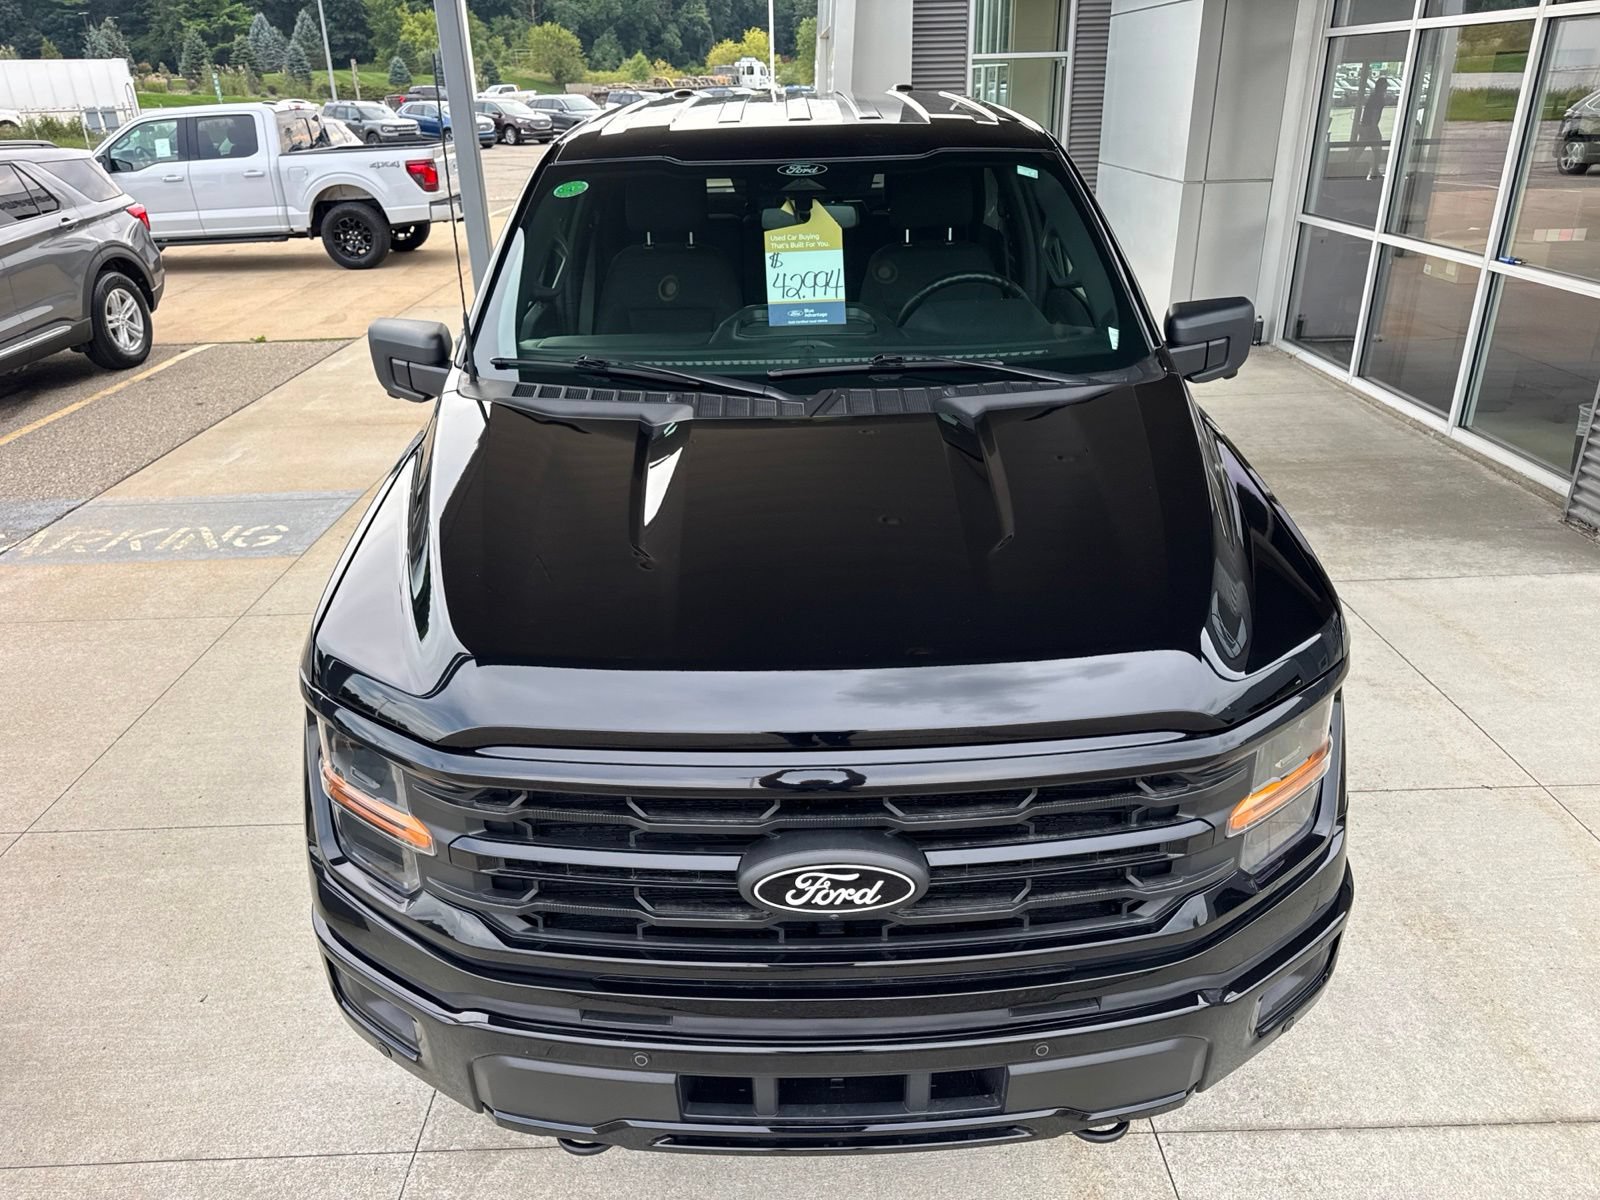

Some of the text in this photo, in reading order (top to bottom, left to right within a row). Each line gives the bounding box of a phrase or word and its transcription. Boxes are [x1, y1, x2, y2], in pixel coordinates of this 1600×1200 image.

[785, 164, 820, 174] Ford
[798, 233, 820, 241] Buying
[790, 241, 805, 249] Built
[769, 252, 784, 268] $
[0, 525, 289, 558] ARKING
[785, 871, 885, 906] Ford
